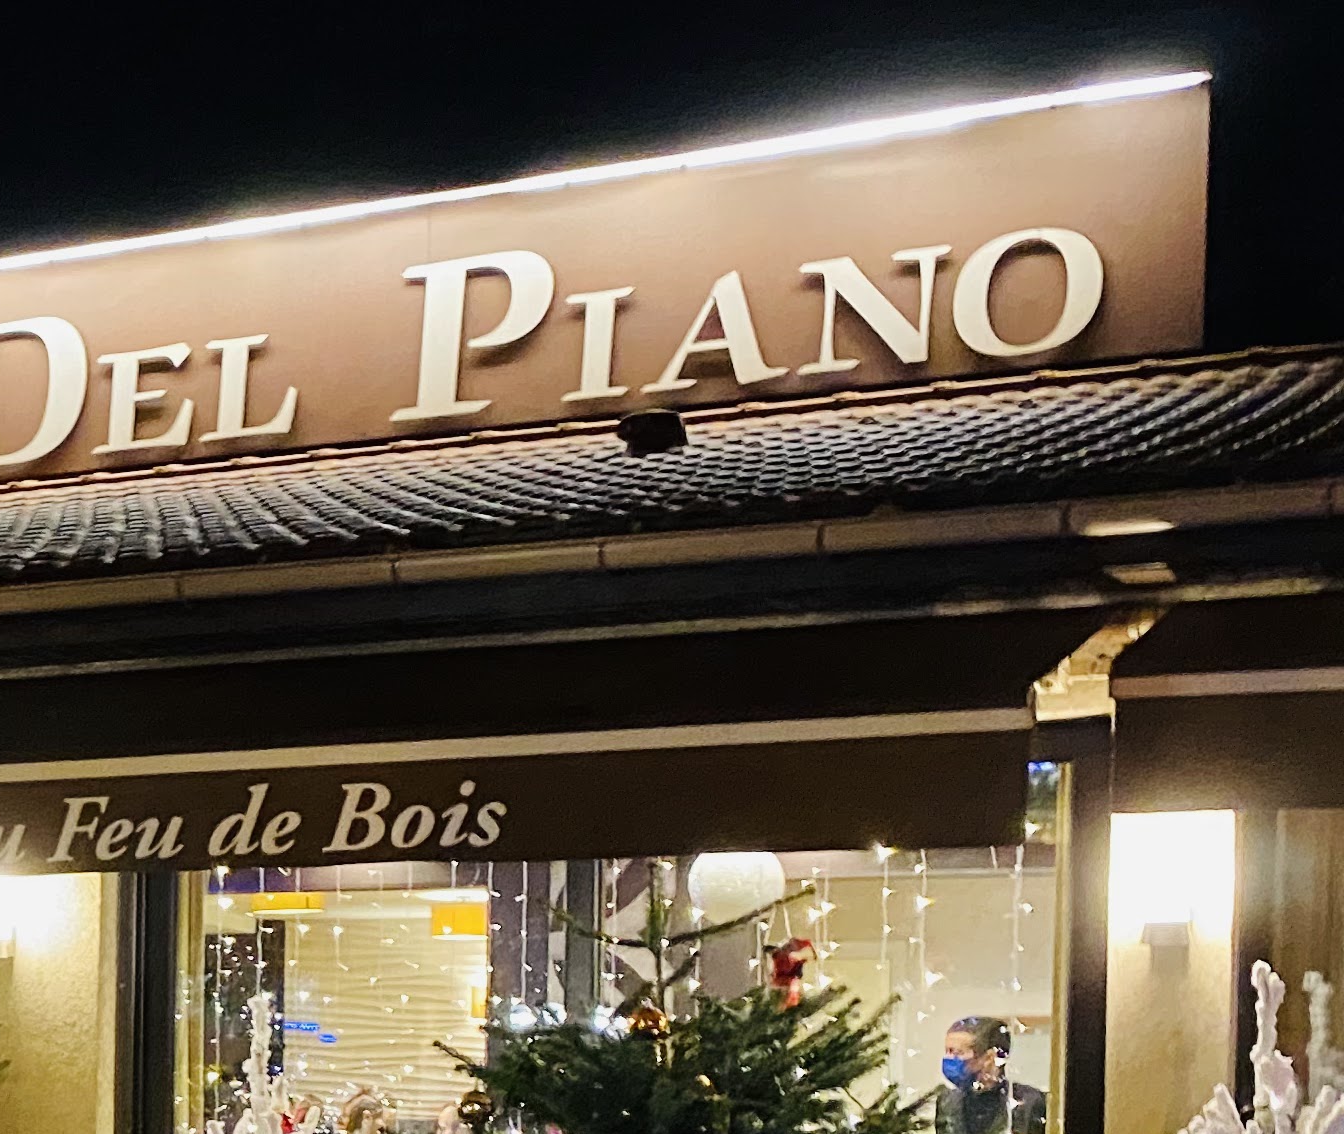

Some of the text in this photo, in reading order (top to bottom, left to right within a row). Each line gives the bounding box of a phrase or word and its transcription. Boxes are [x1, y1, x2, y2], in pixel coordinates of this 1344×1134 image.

[388, 226, 1105, 423] PIANO
[47, 795, 184, 864] Feu
[207, 782, 302, 857] de
[321, 779, 508, 853] Bois
